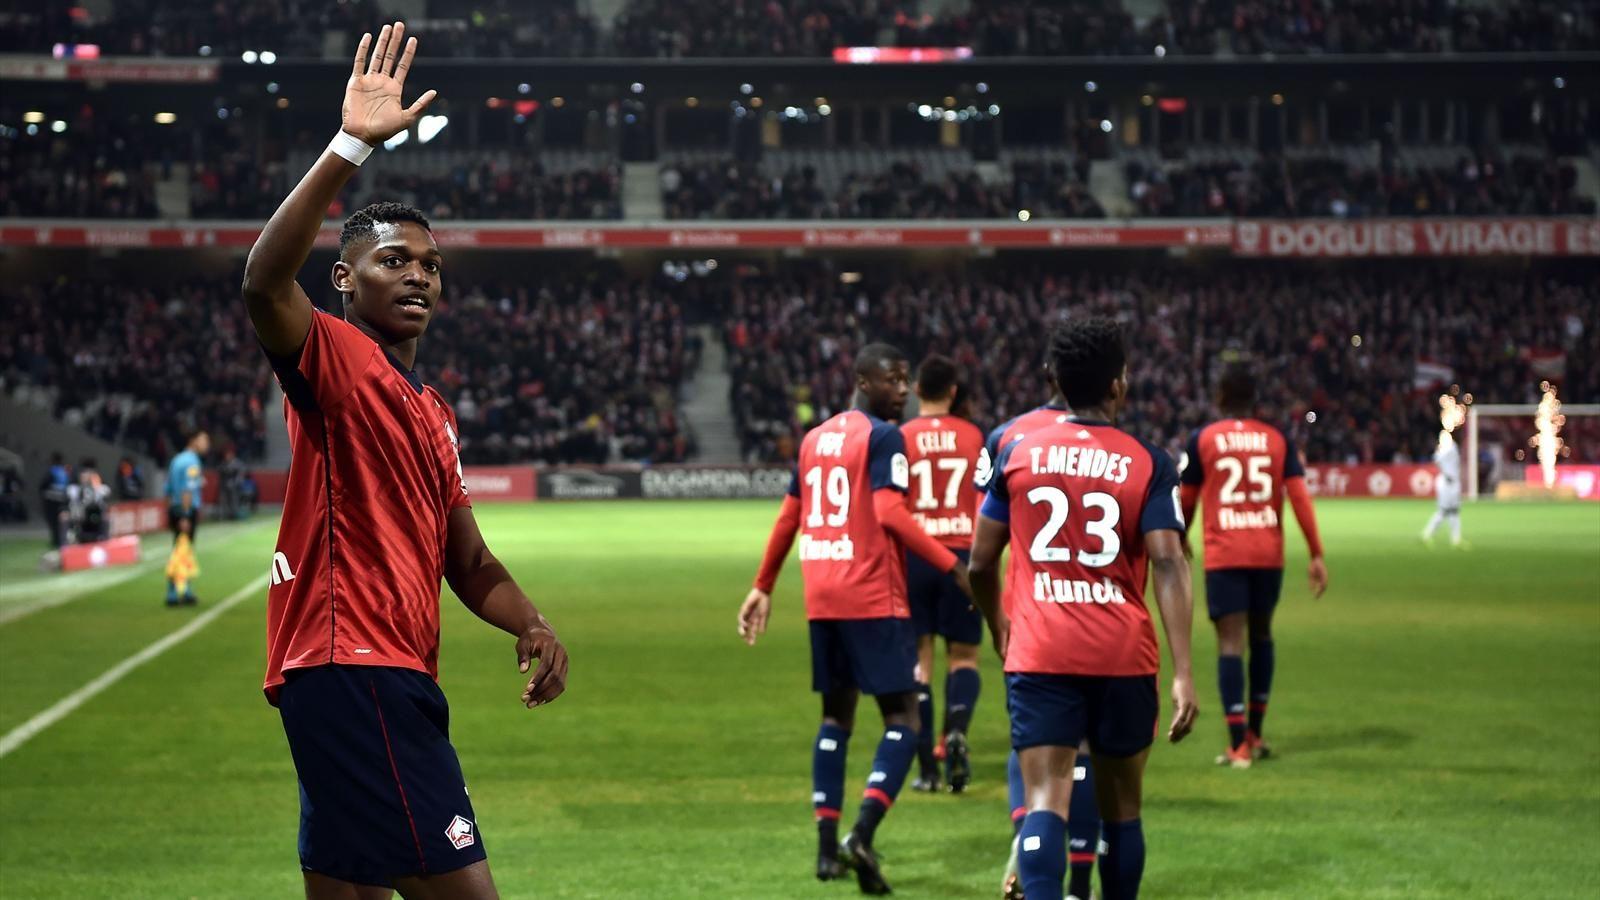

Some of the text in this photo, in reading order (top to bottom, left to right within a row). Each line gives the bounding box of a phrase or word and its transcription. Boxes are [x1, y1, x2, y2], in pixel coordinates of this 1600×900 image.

[1268, 221, 1416, 255] DOGUES
[1424, 221, 1556, 255] VIRAGE
[916, 431, 957, 455] ÇELIK
[1029, 445, 1132, 484] T.MENDES
[805, 465, 850, 528] 19
[910, 457, 968, 509] 17
[1215, 455, 1273, 504] 25
[1026, 486, 1120, 568] 23
